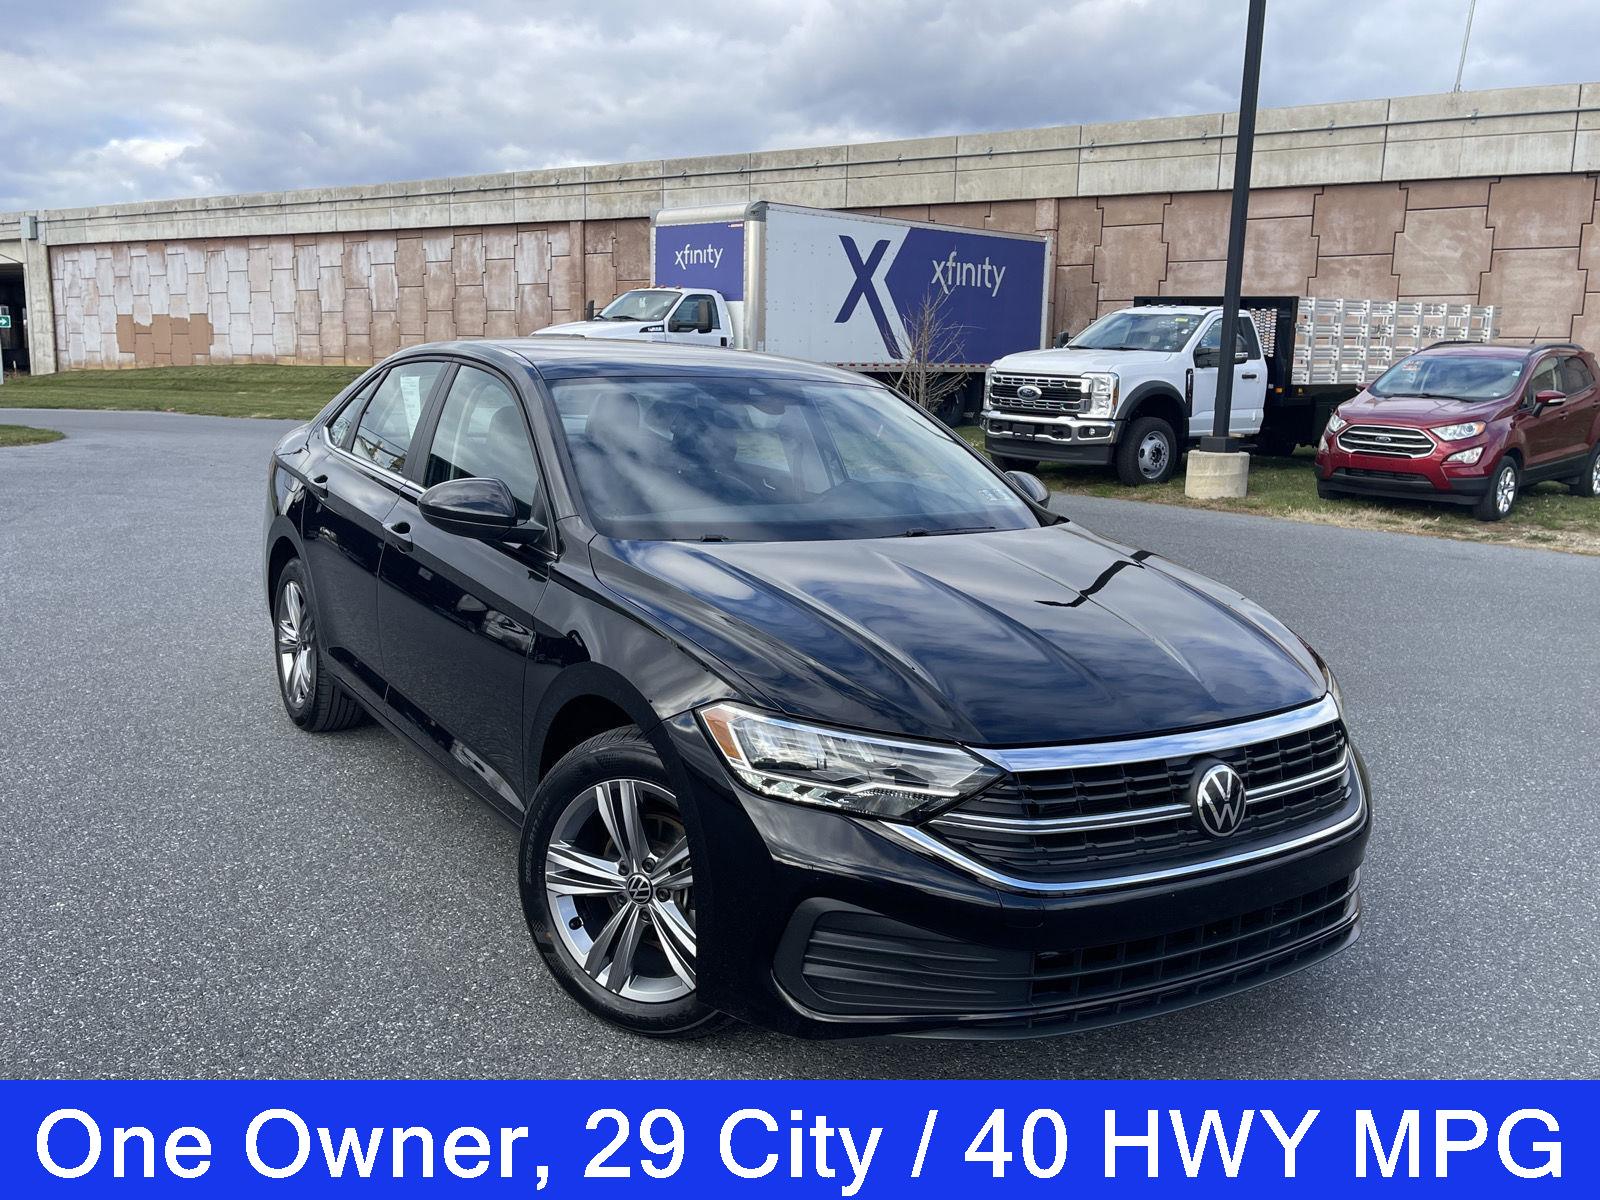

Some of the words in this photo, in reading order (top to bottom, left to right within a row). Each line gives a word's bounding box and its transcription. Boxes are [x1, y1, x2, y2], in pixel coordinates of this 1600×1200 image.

[674, 243, 724, 270] xfinity
[931, 251, 1006, 297] xfinity
[834, 234, 904, 360] X
